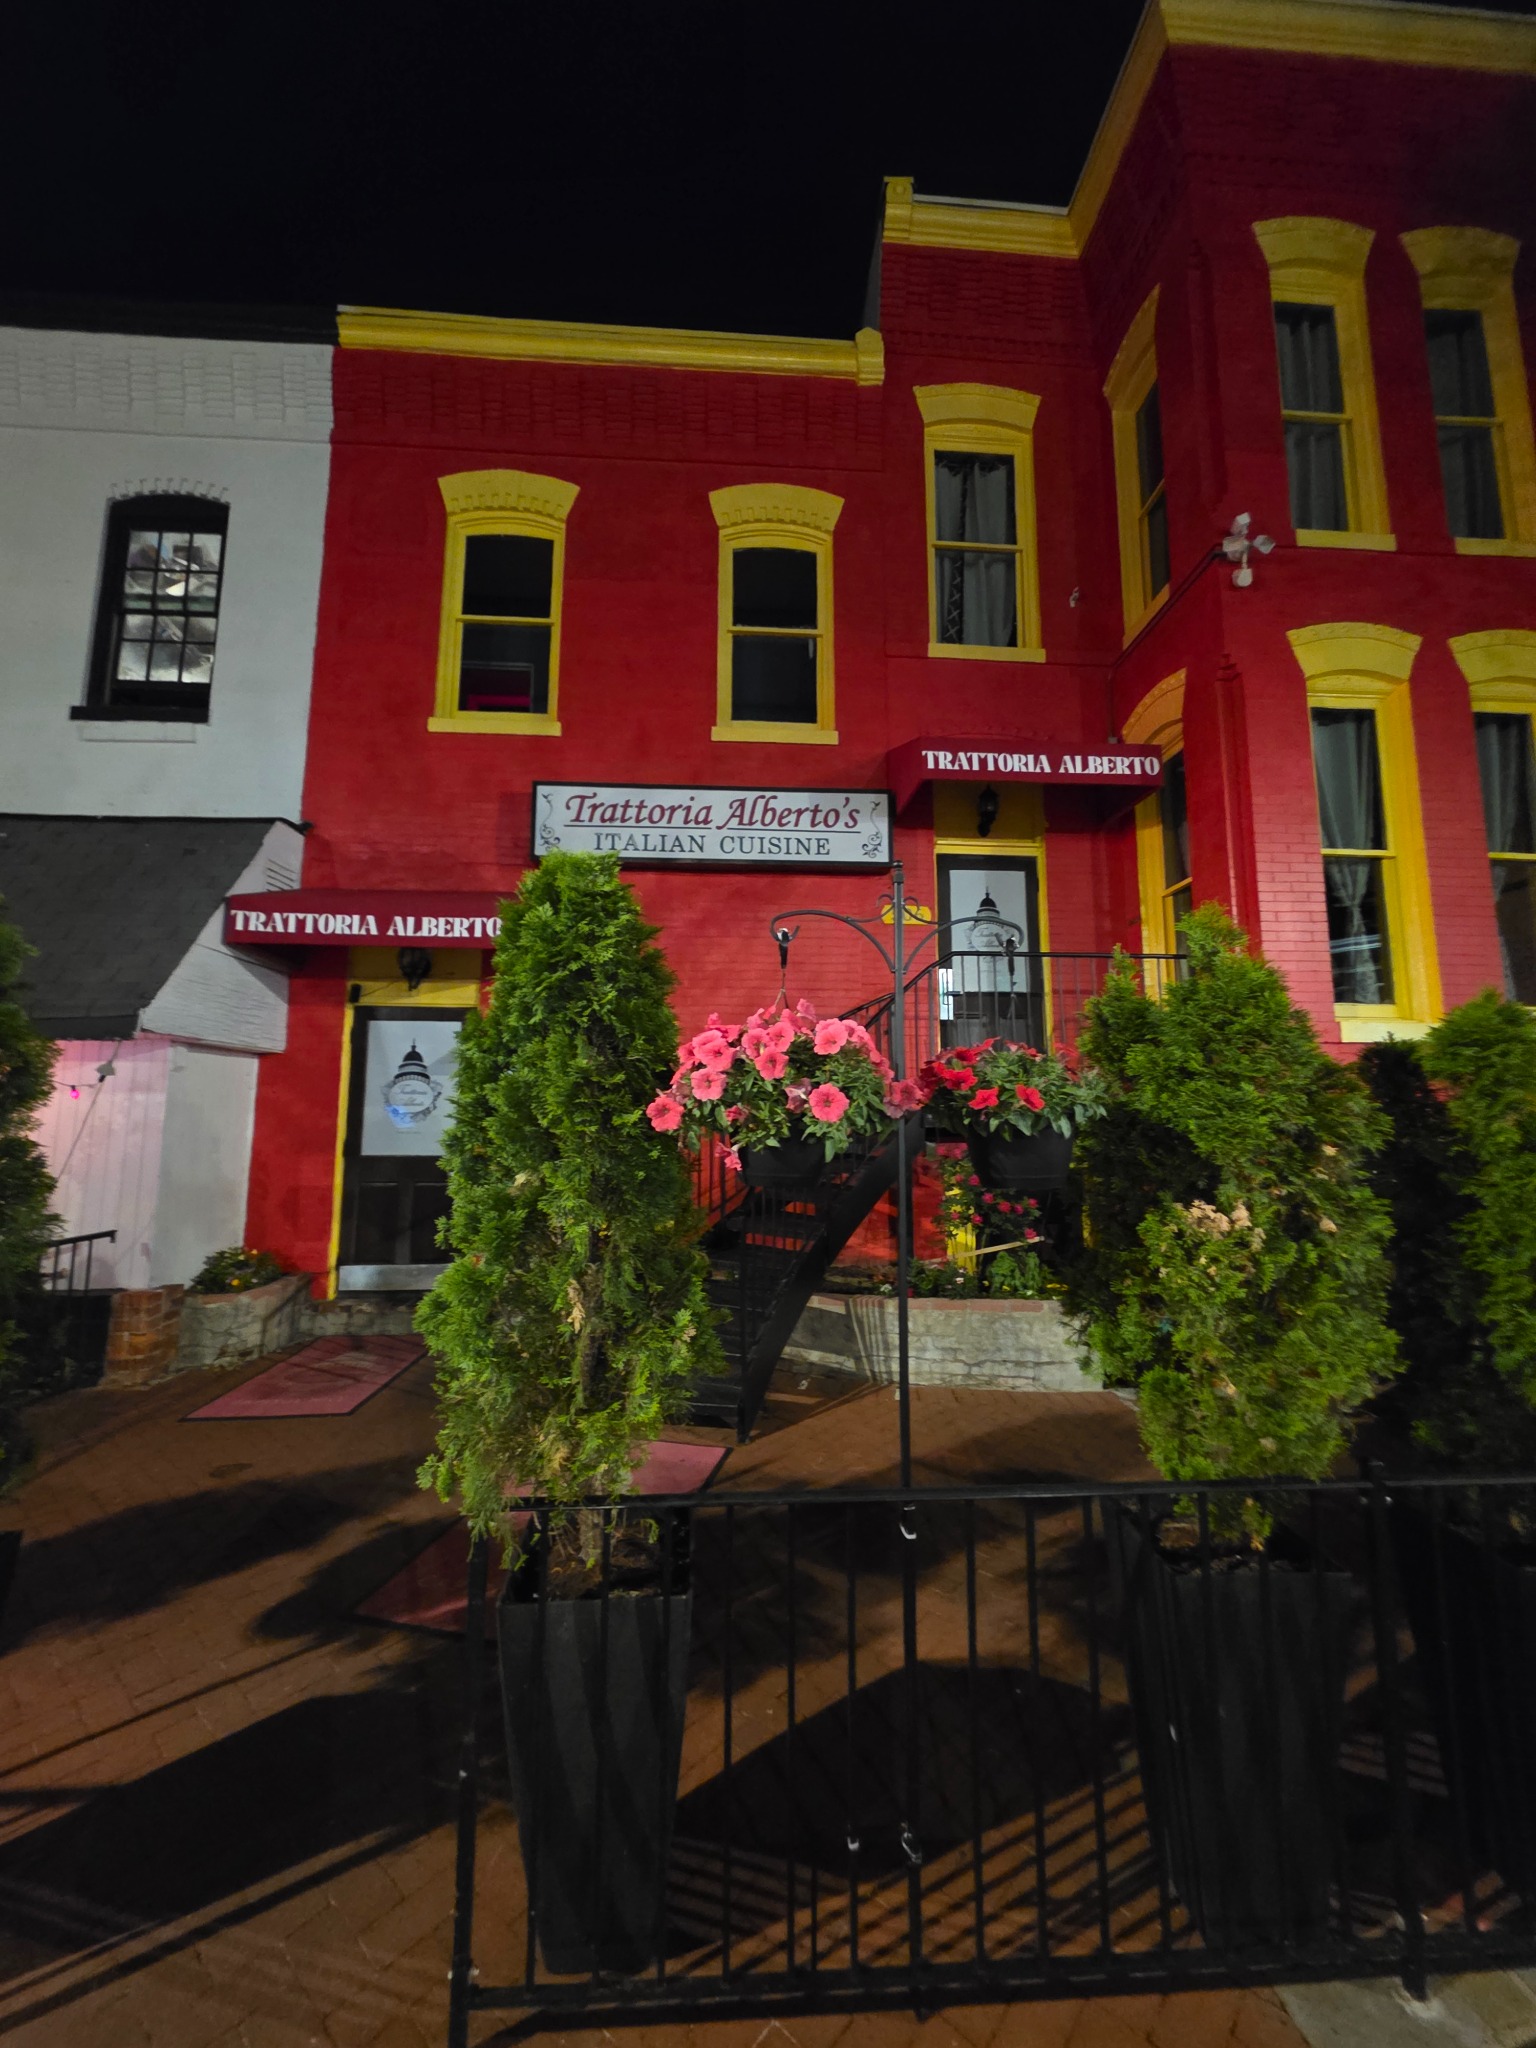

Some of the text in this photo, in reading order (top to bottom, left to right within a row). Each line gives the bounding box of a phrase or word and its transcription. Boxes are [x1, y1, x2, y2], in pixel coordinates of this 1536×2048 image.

[922, 750, 1160, 776] TRATTORIA ALBERTO
[565, 792, 860, 830] Trattoria Alberto's
[593, 832, 831, 856] ITALIAN CUISINE
[230, 909, 502, 938] TRATTORIA ALBERTO
